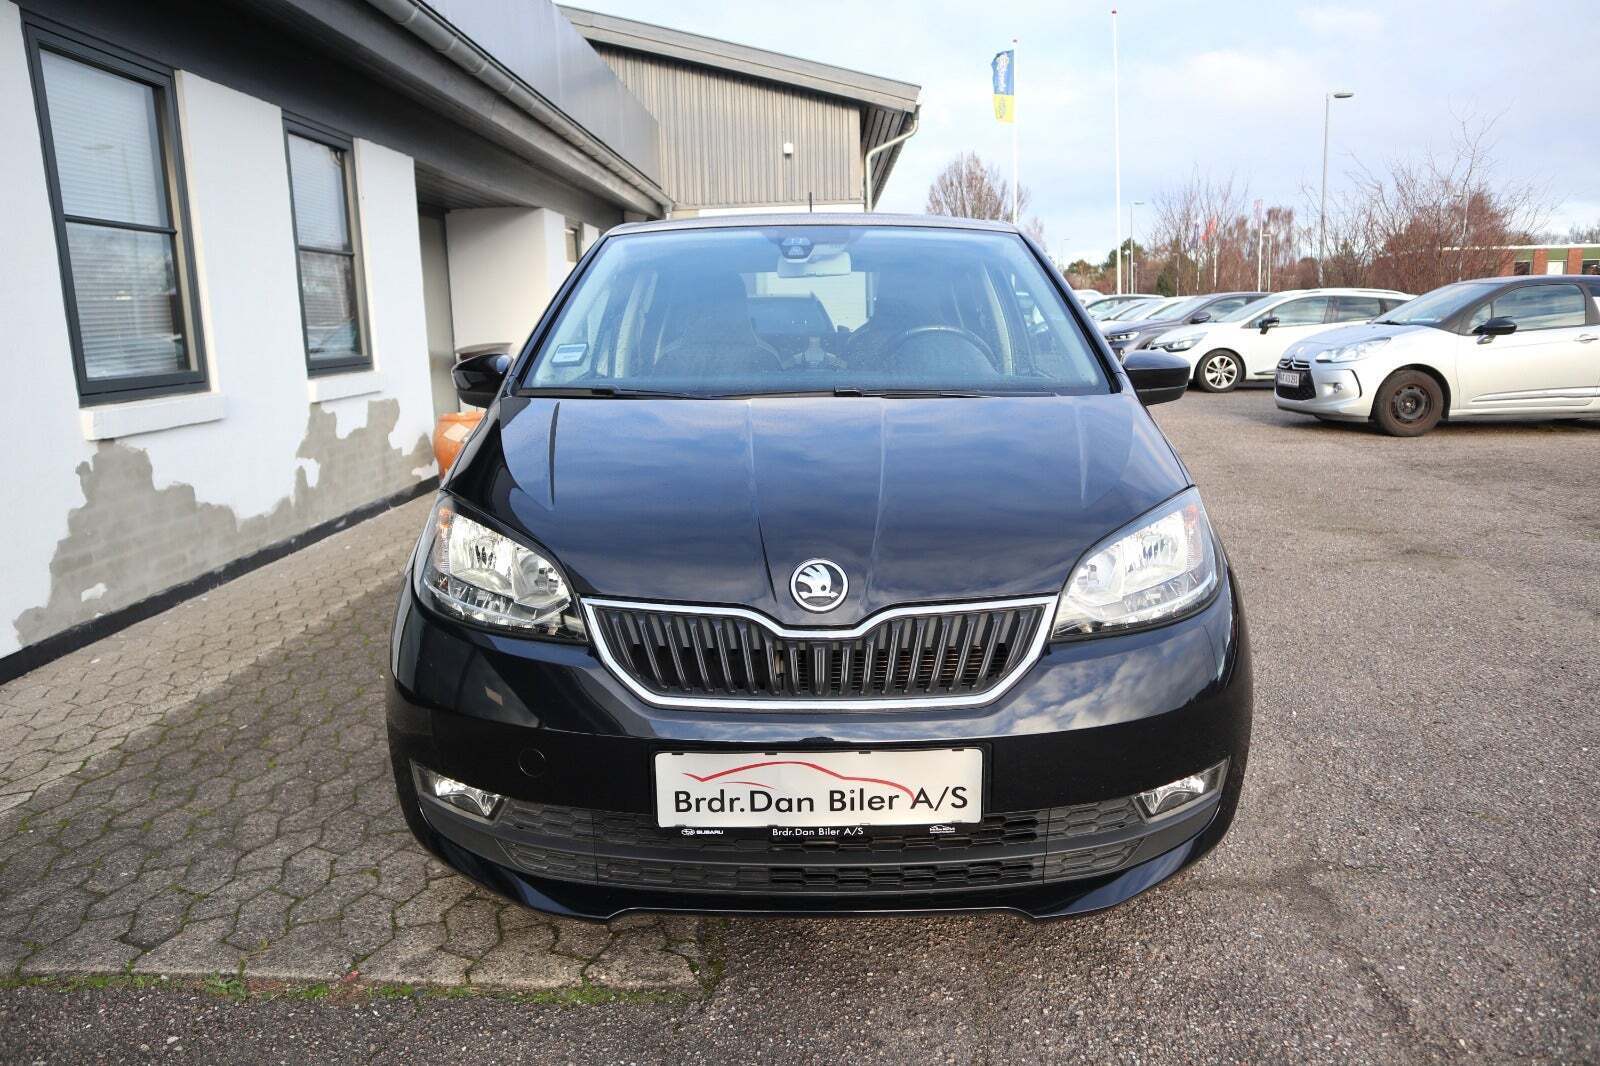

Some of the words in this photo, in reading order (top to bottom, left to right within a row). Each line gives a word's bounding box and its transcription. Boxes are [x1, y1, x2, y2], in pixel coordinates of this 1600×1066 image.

[674, 790, 814, 813] Brdr.Dan
[829, 788, 899, 812] Biler
[910, 786, 968, 811] A/S
[772, 827, 815, 836] Brdr.Dan
[818, 827, 840, 836] Biler
[843, 827, 864, 836] A/S
